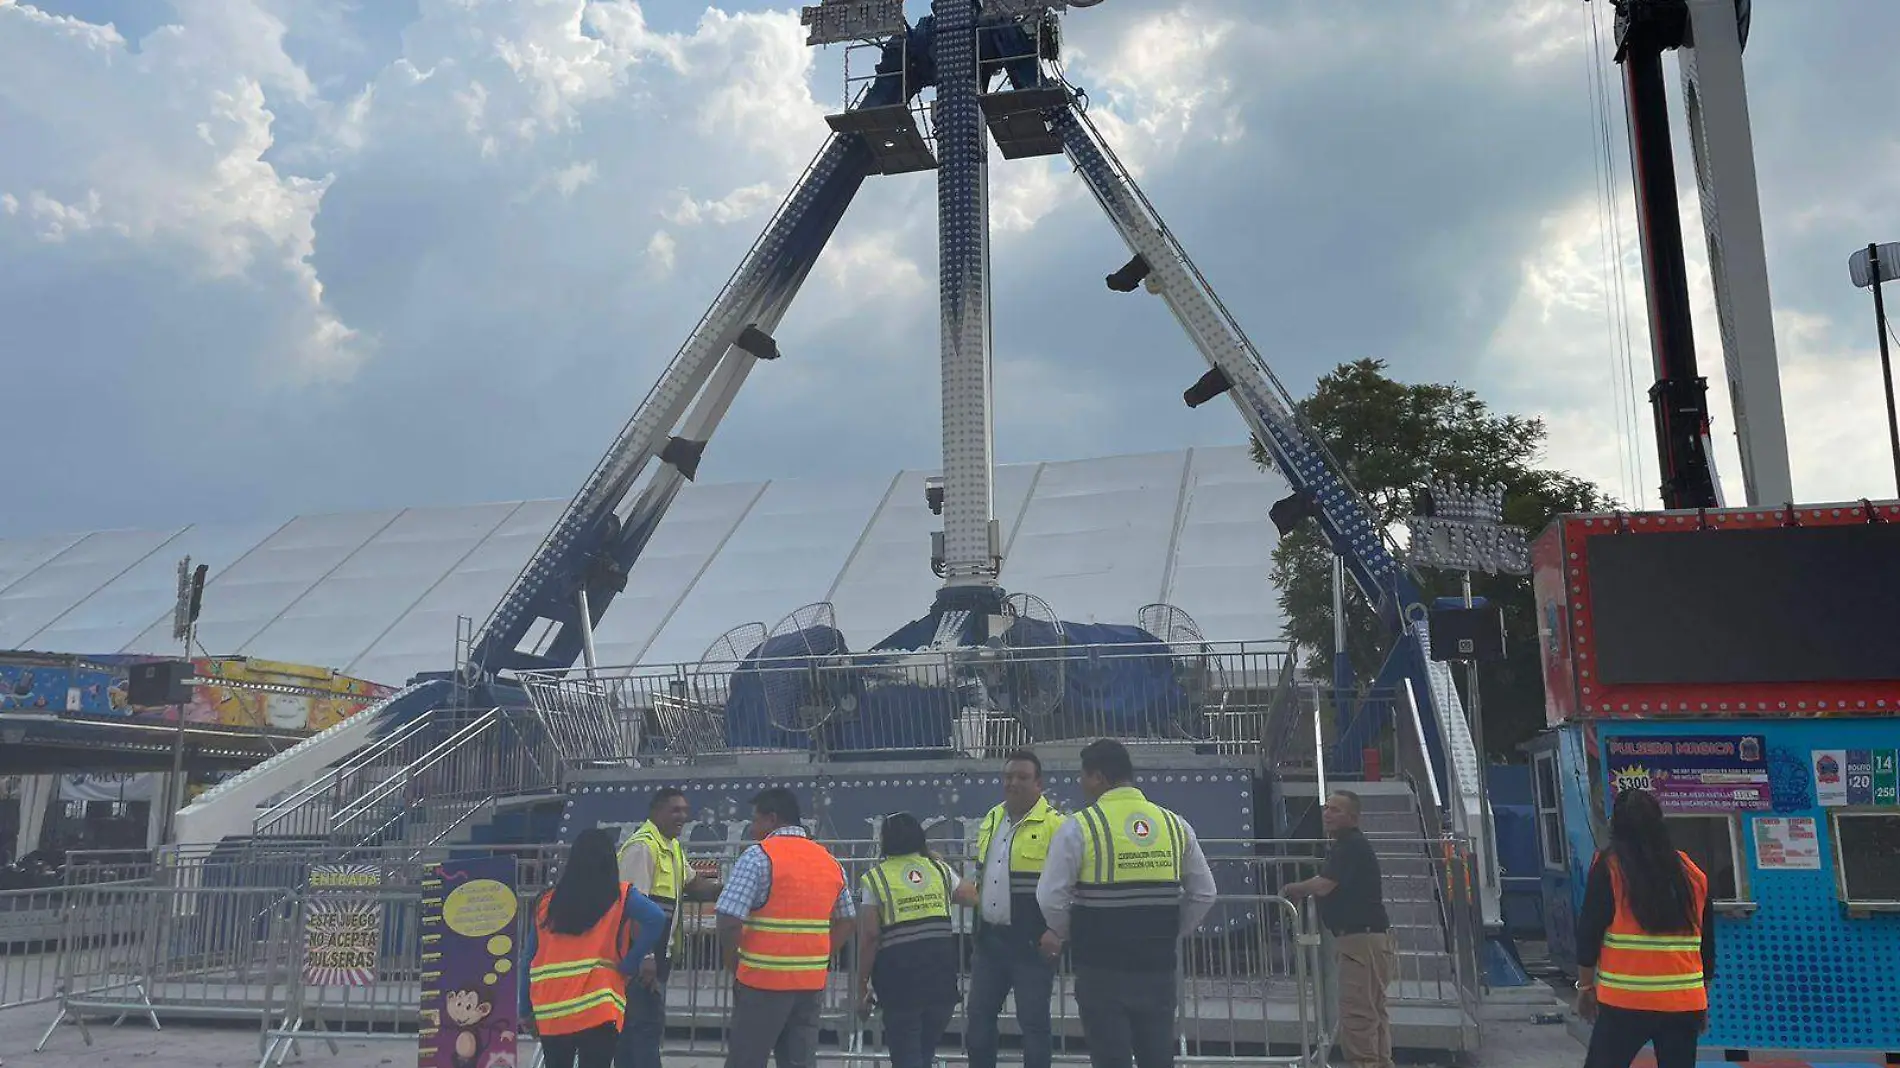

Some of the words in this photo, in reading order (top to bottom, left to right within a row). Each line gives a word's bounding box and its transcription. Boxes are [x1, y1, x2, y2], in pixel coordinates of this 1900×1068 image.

[1411, 519, 1530, 573] KING
[1611, 741, 1671, 755] PULSERA
[1876, 756, 1892, 769] 14
[1618, 776, 1649, 791] $300
[310, 872, 377, 887] ENTRADA
[310, 914, 337, 927] ESTE
[339, 914, 376, 927] JUEGO
[309, 932, 324, 946] NO
[328, 931, 377, 947] ACEPTA
[309, 951, 376, 968] PULSERAS
